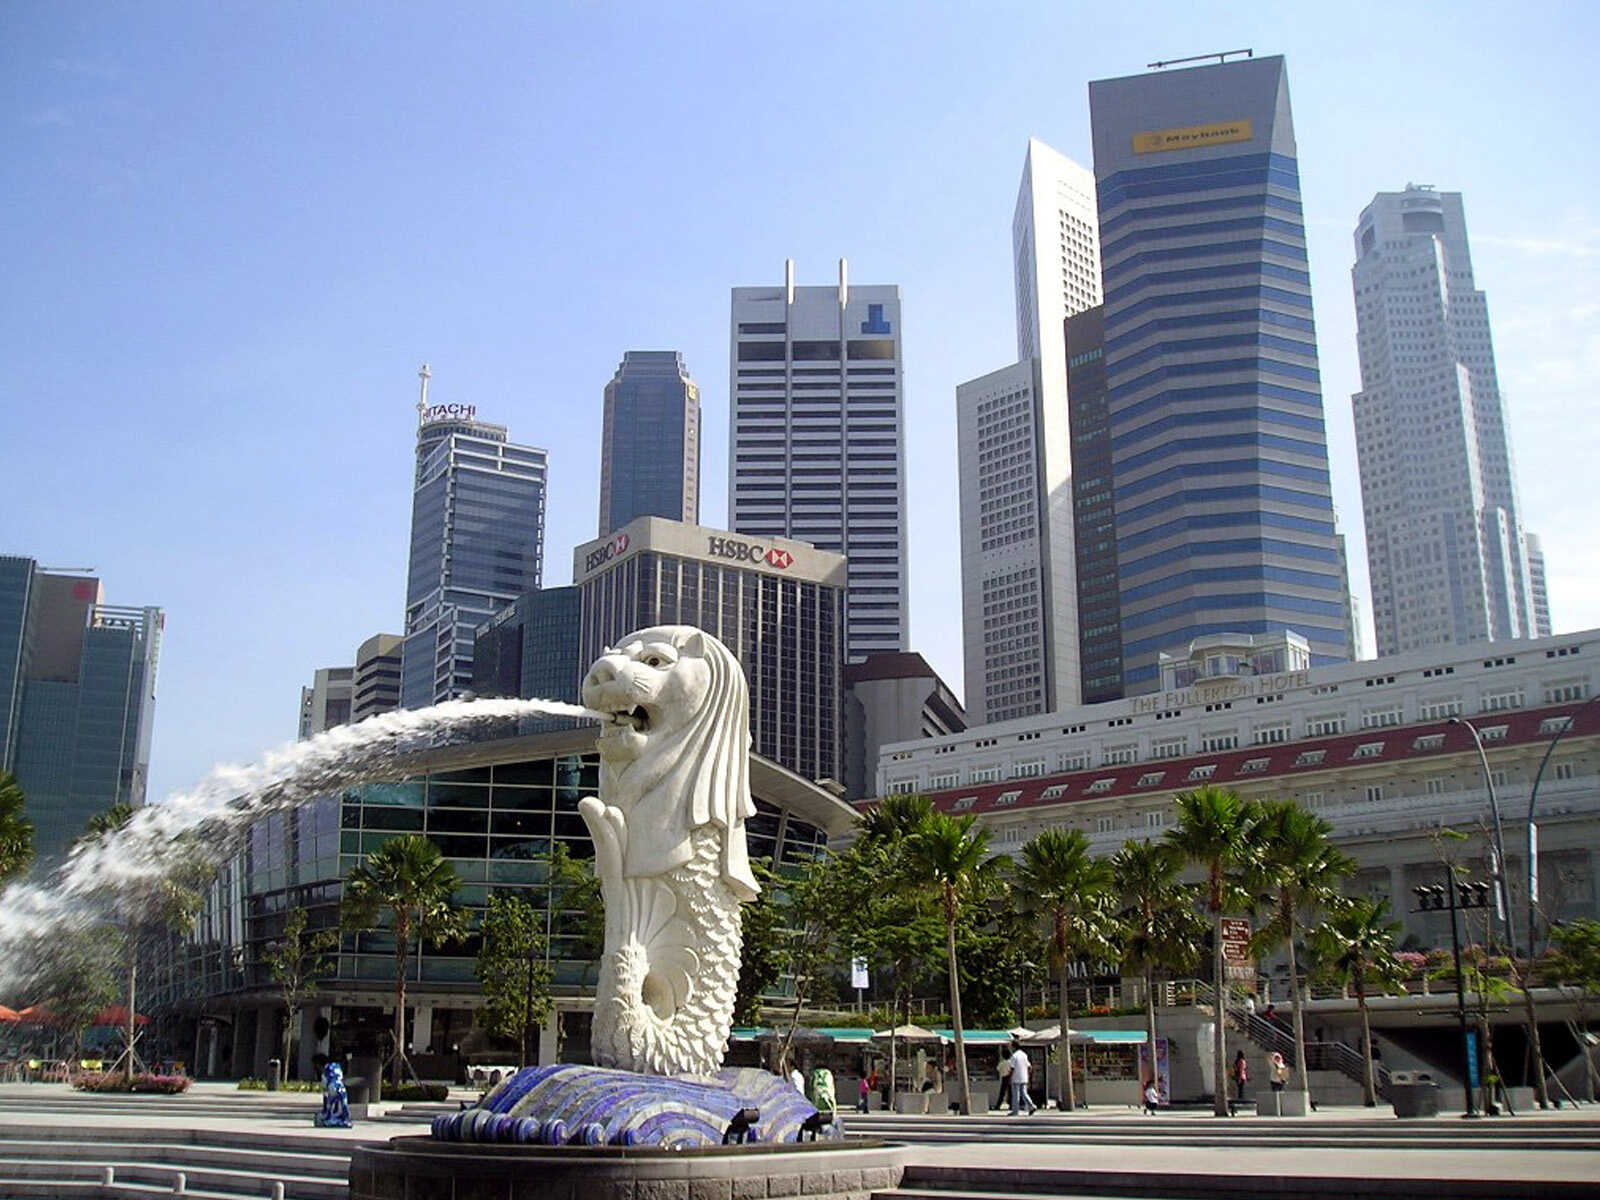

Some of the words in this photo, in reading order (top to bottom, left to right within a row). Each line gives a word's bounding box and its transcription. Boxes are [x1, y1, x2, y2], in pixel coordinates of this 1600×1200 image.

[424, 402, 476, 418] ITACHI
[585, 541, 614, 573] HSBC
[708, 535, 764, 564] HSBC
[1131, 696, 1159, 713] THE
[1166, 681, 1254, 708] FULLERTON
[1259, 672, 1312, 694] HOTEL
